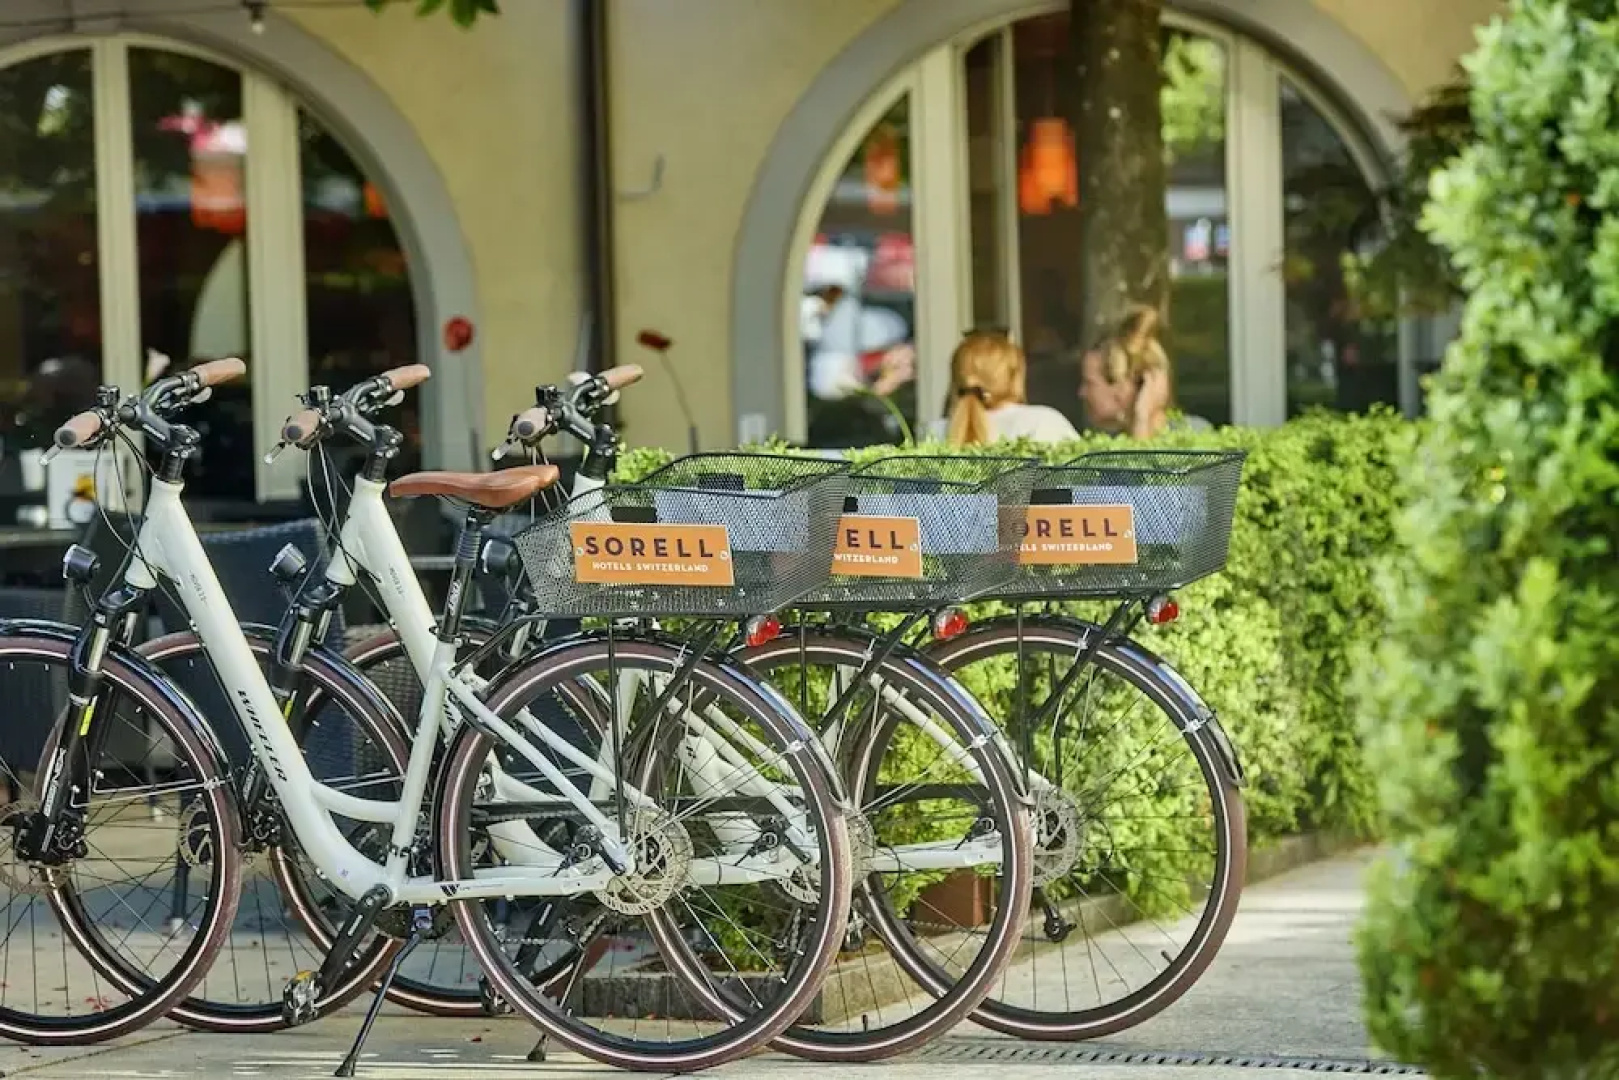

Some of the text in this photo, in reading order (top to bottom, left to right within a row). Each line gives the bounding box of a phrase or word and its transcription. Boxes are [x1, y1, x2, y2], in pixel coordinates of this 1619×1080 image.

[1013, 517, 1118, 538] ORELL
[585, 536, 713, 558] SORELL
[846, 528, 904, 550] ELL
[1041, 543, 1113, 552] SWITZERLAND
[592, 561, 709, 573] HOTELS SWITZERLAND
[833, 553, 899, 565] WITZERLAND
